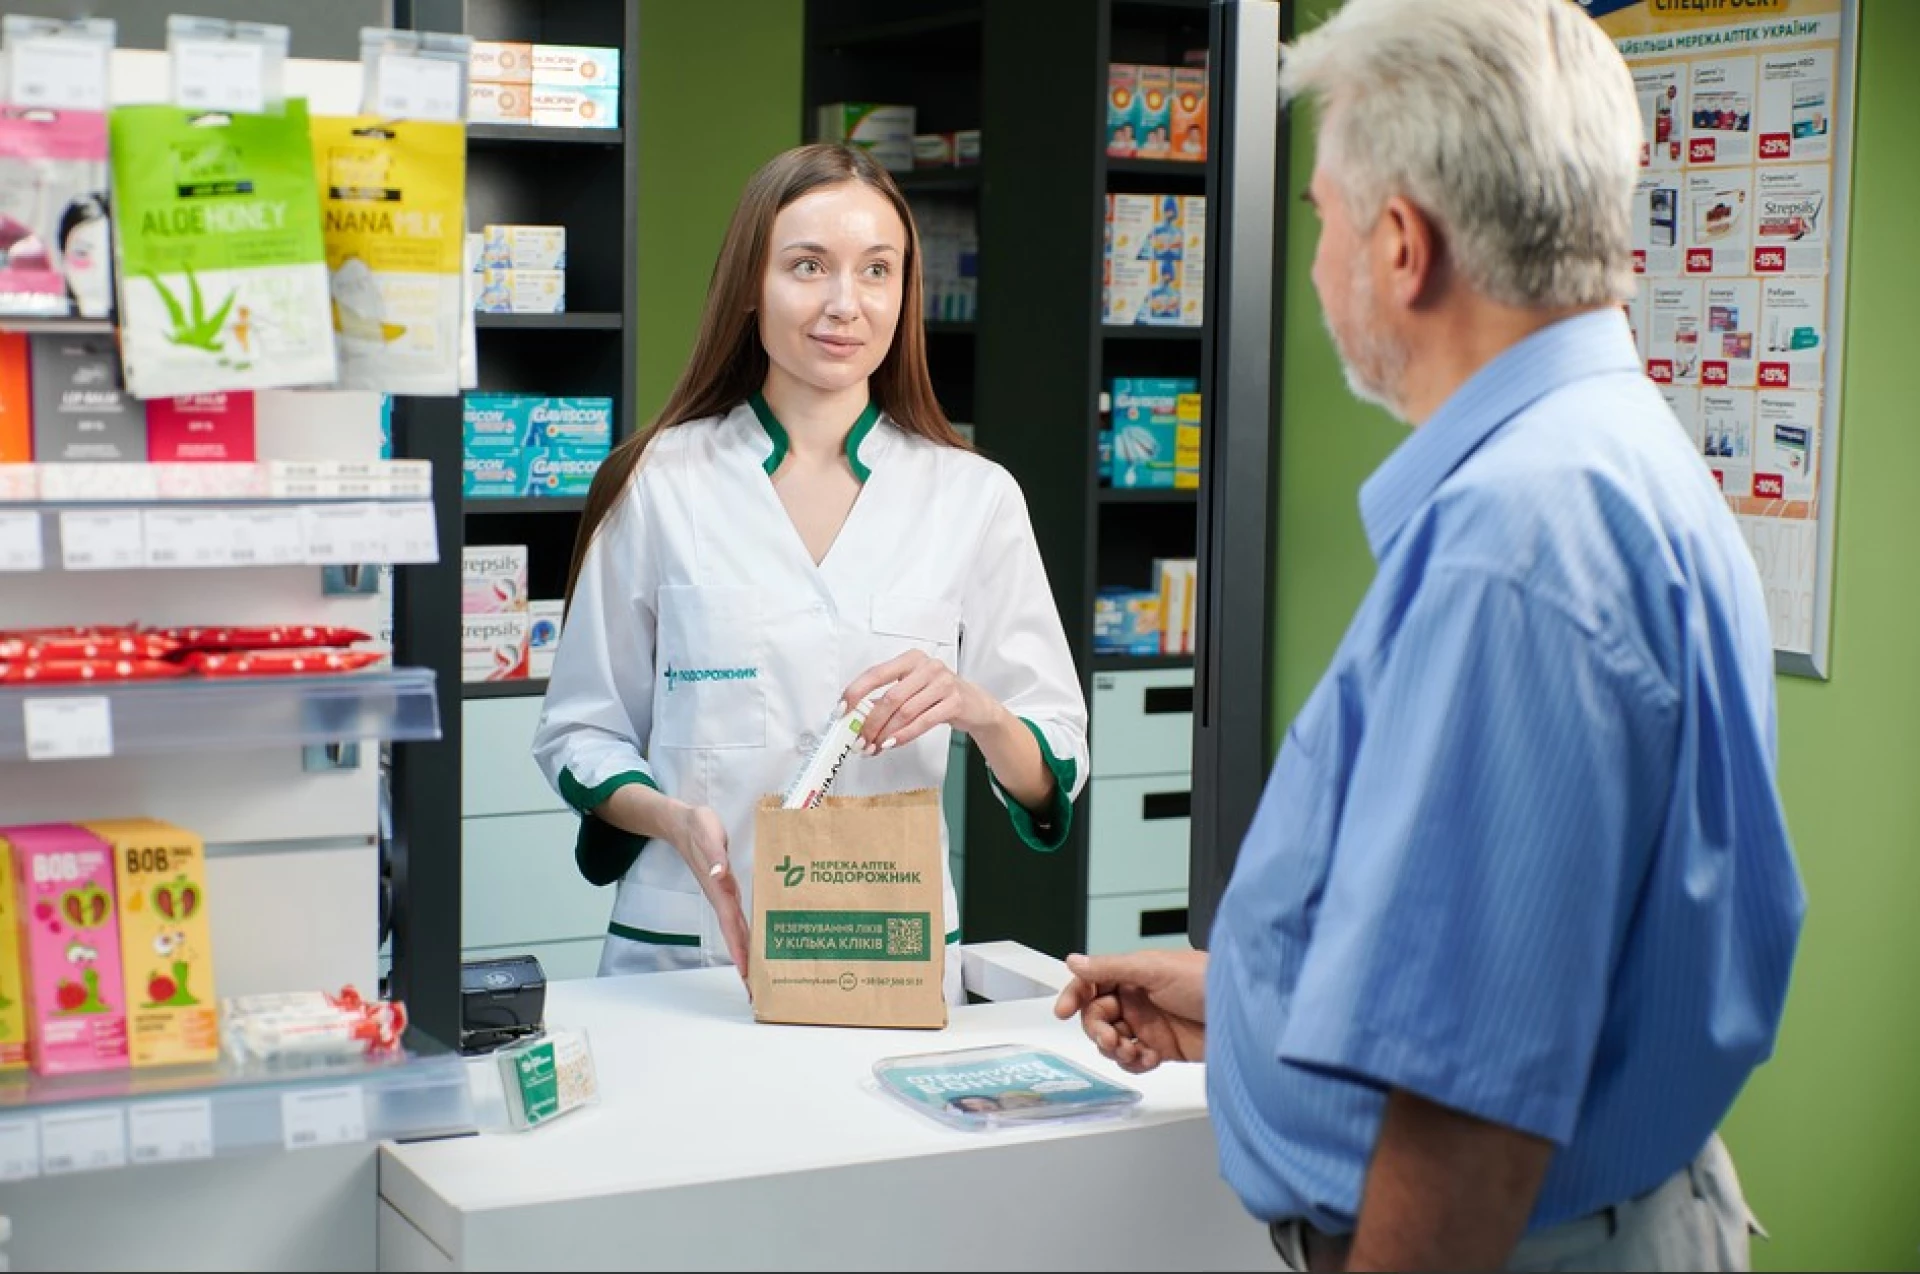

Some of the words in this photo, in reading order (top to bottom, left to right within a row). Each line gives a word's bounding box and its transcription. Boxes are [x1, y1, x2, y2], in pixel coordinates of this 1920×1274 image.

[1675, 33, 1721, 50] МЕРЕЖА
[1723, 28, 1759, 44] АПТЕК
[1764, 200, 1816, 217] Strepsils
[127, 846, 169, 873] BOB
[810, 861, 858, 870] МЕРЕЖА
[861, 861, 897, 870] АПТЕК
[32, 852, 78, 883] BOB
[810, 871, 922, 884] ПОДОРОЖНИК
[773, 923, 854, 934] РЕЗЕРВУВАННЯ
[855, 923, 883, 934] ЛІКІВ
[773, 938, 785, 950] У
[786, 938, 837, 950] КІЛЬКА
[839, 938, 883, 950] КЛІКІВ
